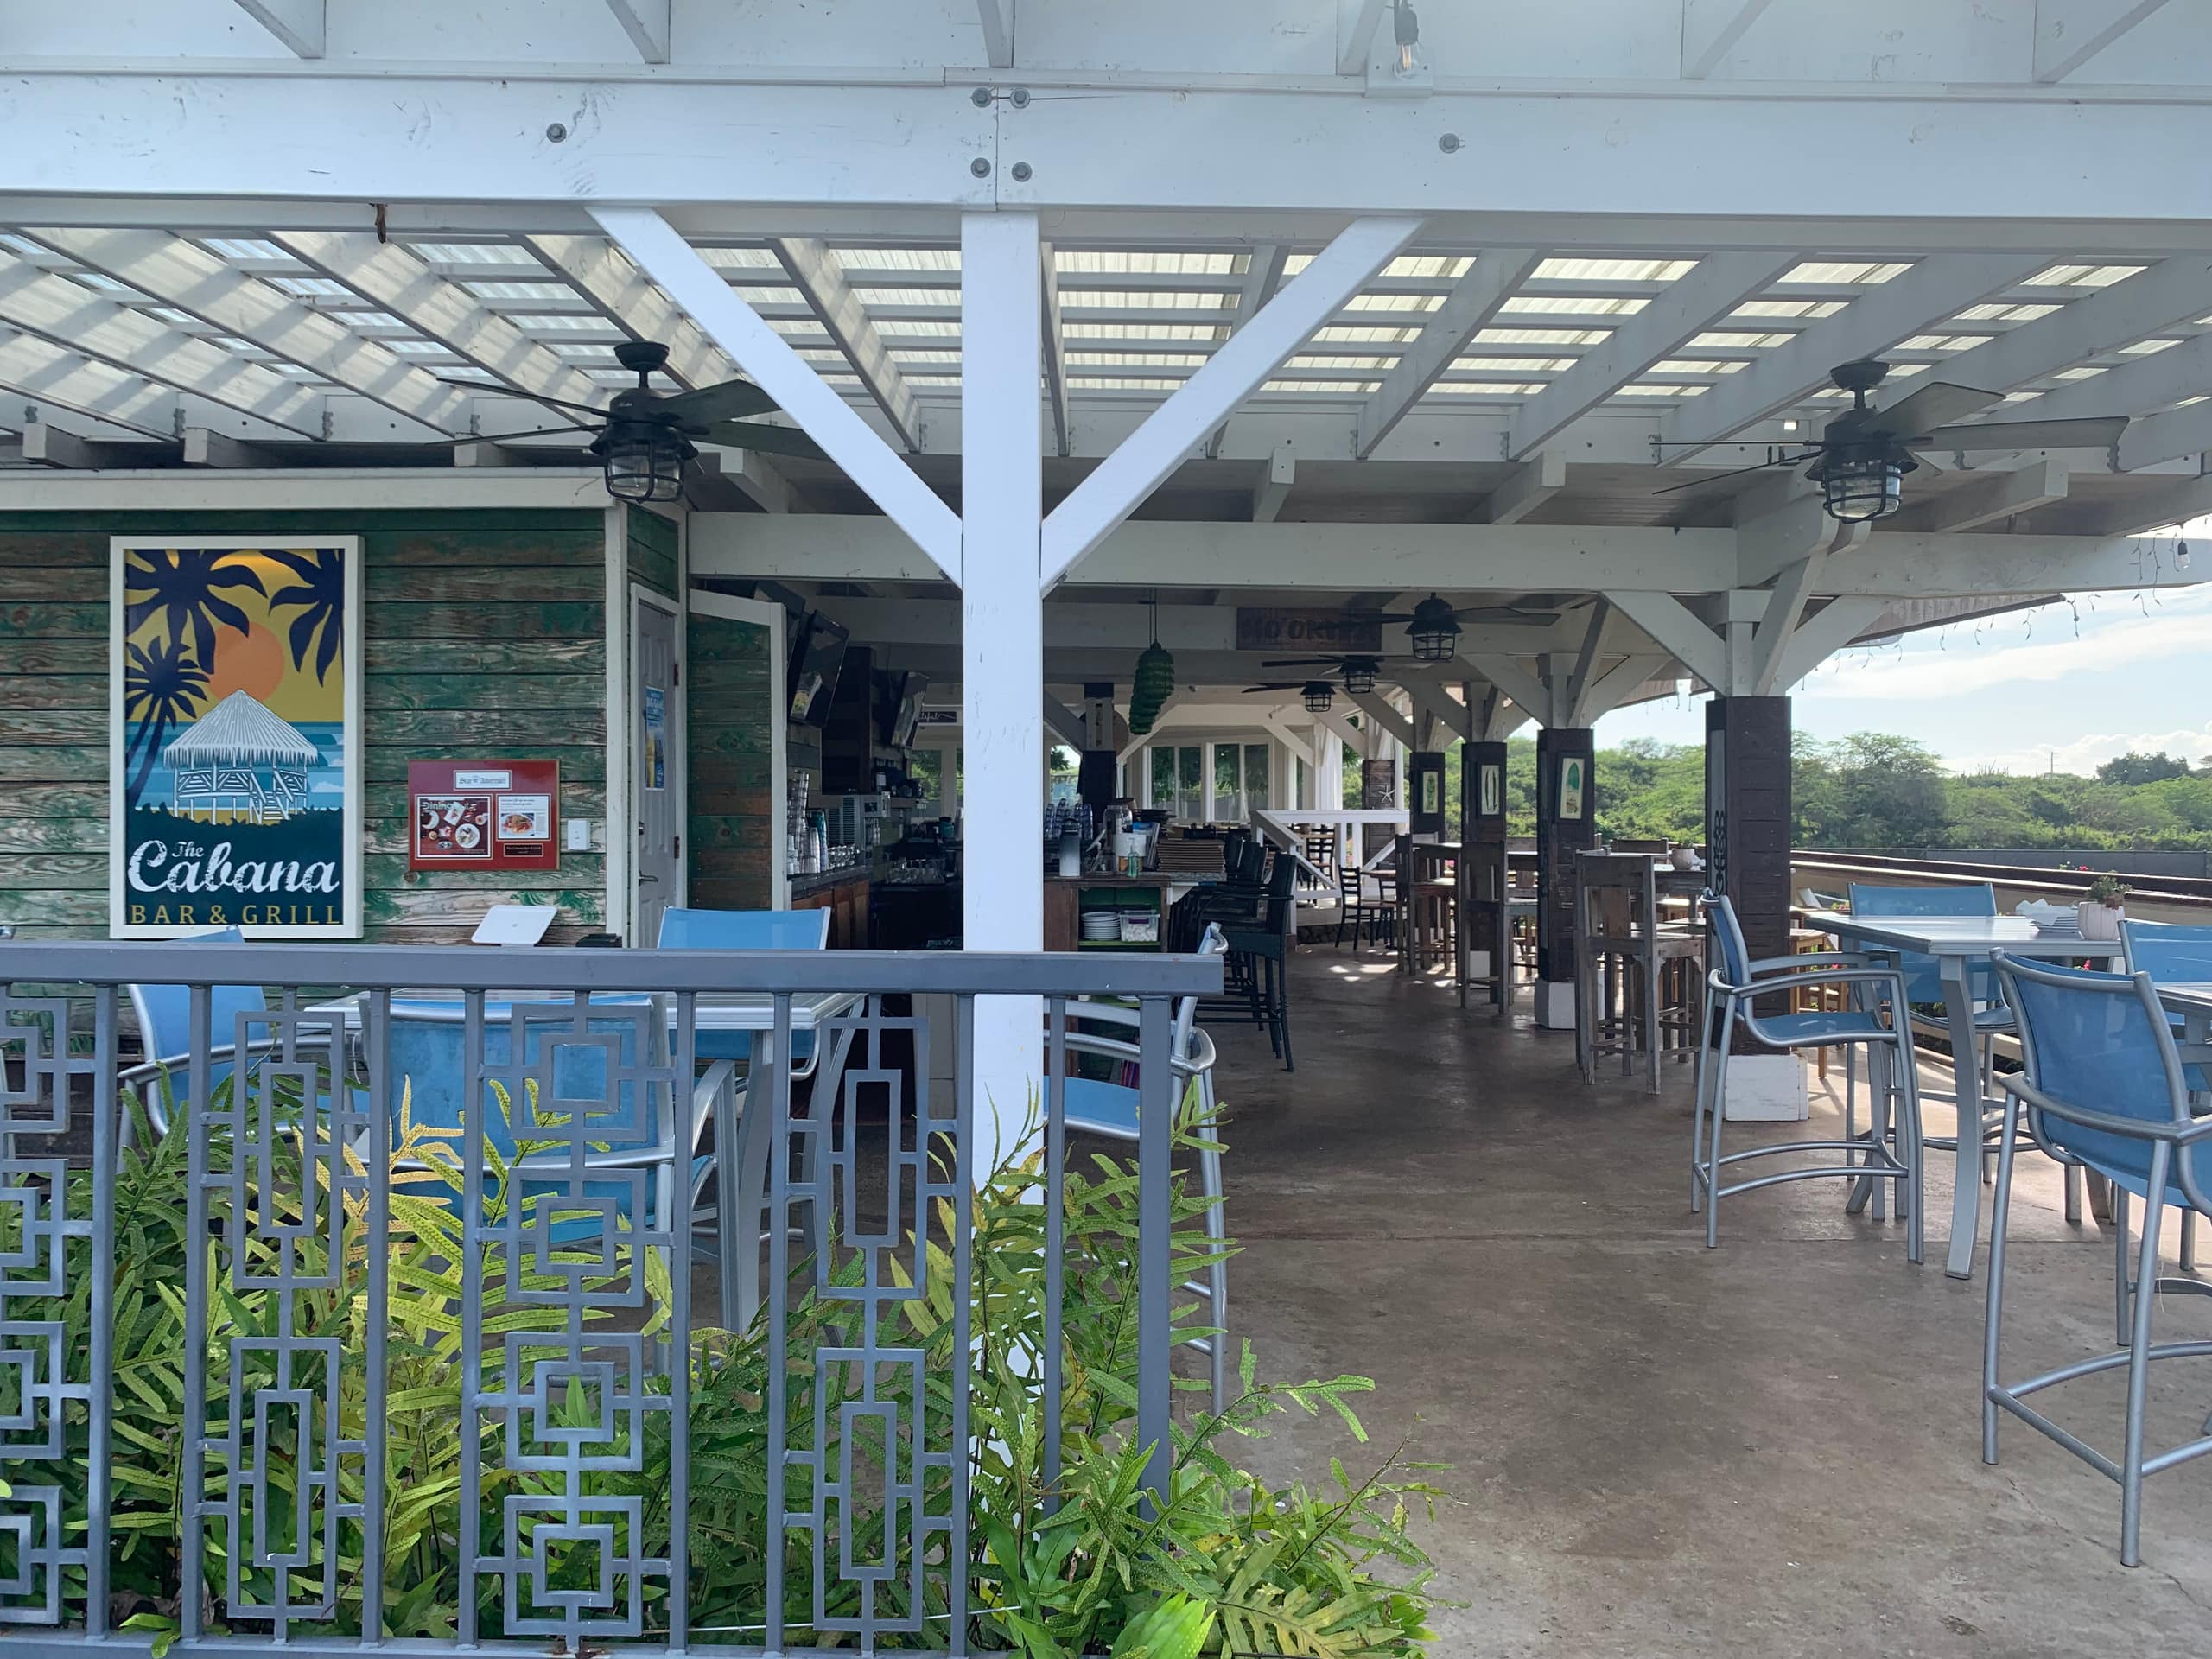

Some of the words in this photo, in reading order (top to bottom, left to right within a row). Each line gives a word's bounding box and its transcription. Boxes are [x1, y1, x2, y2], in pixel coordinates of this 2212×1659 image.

[172, 841, 205, 858] The
[127, 839, 340, 893] Cabana
[130, 905, 196, 925] BAR
[209, 904, 228, 925] &
[242, 905, 340, 925] GRILL
